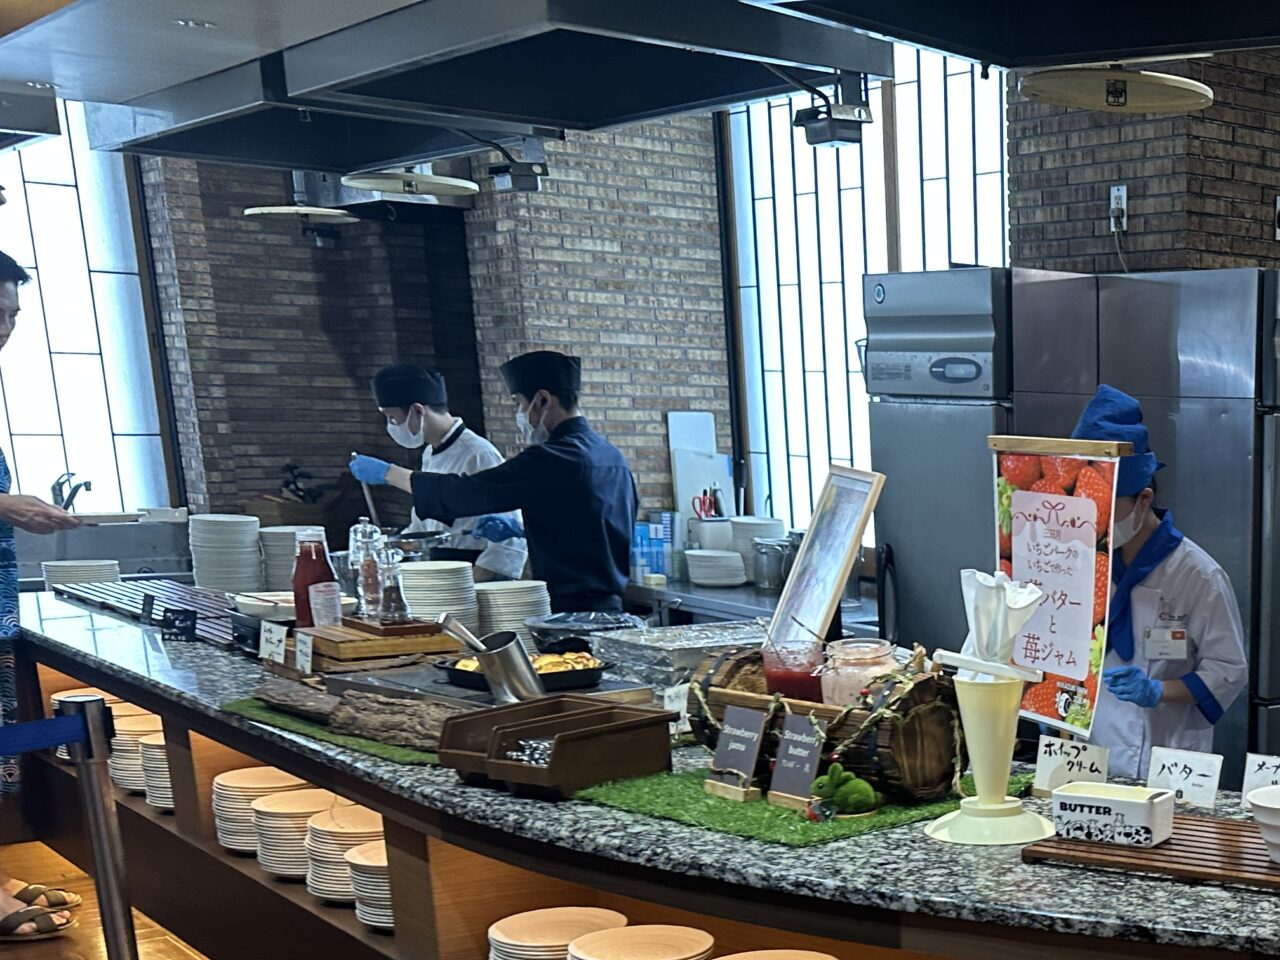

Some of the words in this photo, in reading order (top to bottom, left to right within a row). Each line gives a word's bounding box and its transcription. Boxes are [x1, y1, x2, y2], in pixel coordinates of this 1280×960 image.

[1048, 614, 1057, 634] と
[1022, 633, 1077, 666] 苺ジャム
[723, 724, 759, 742] Strawberry
[787, 745, 810, 757] butter
[1043, 740, 1088, 759] ホイップ
[1066, 760, 1102, 774] クリーム
[1157, 762, 1213, 781] バター
[1059, 801, 1113, 817] BUTTER
